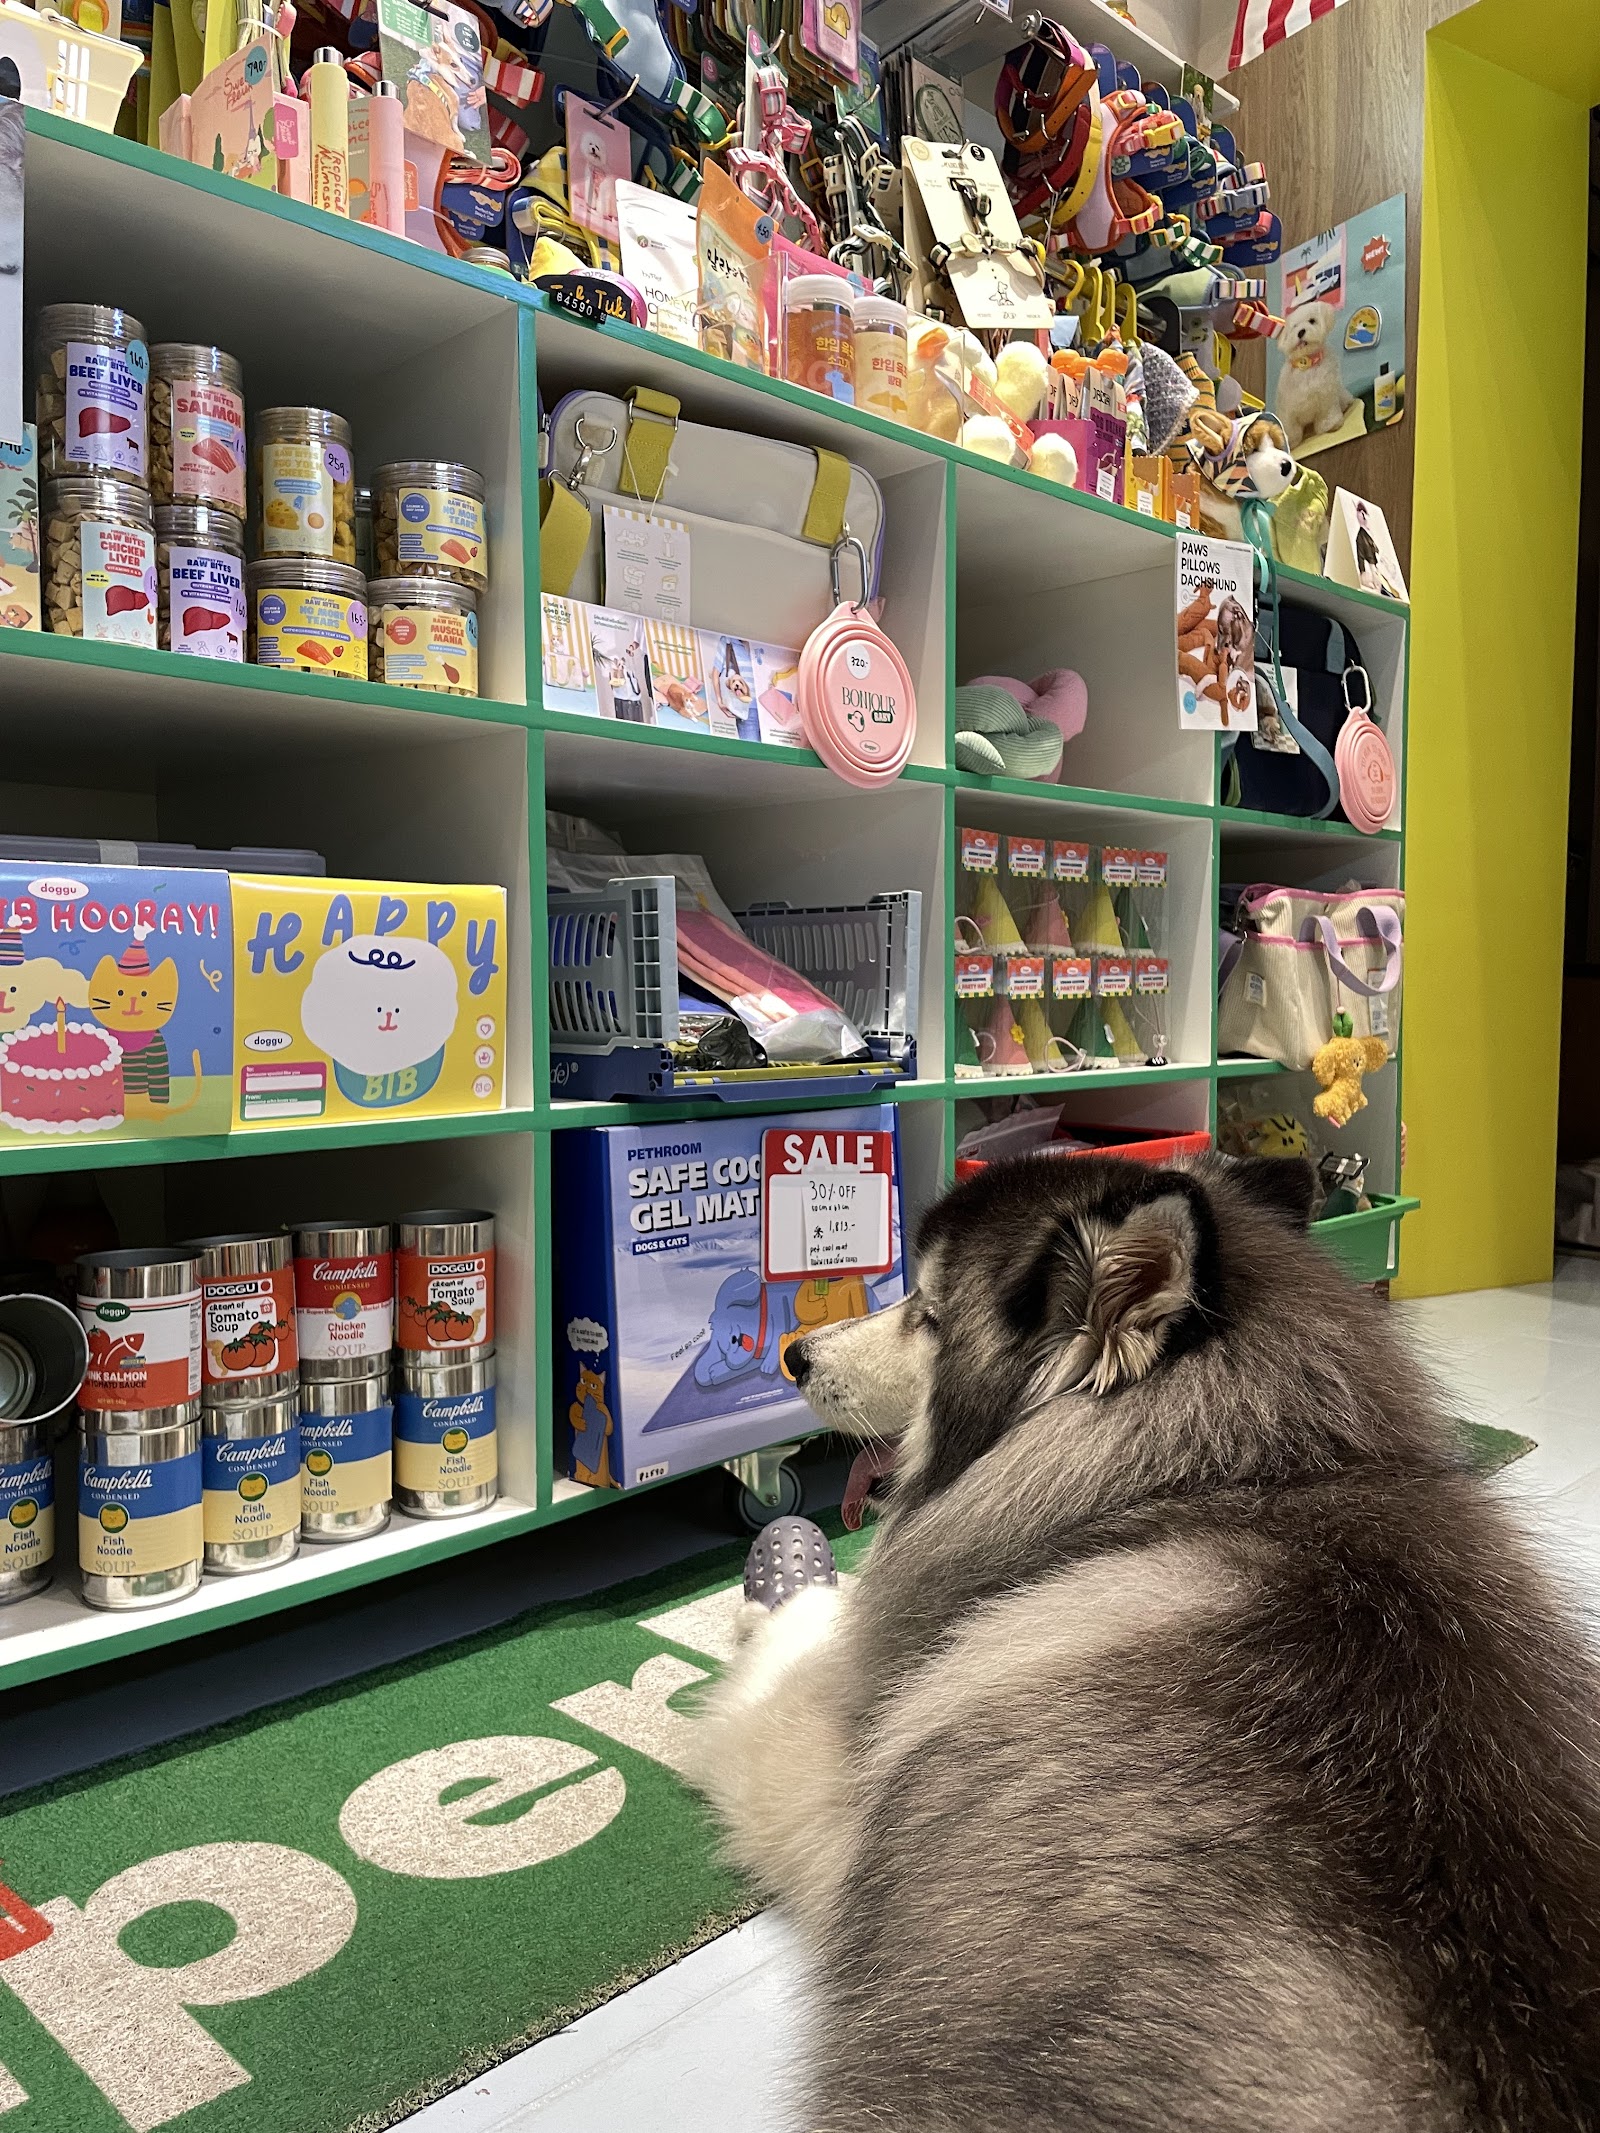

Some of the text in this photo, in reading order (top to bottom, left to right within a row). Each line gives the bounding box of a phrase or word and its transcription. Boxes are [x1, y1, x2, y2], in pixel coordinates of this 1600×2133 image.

[85, 355, 108, 367] RAW
[110, 361, 134, 376] BITE
[69, 364, 143, 395] BEEF LIVER
[176, 397, 242, 429] SALMON
[100, 540, 146, 558] CHICKEN
[1181, 541, 1209, 557] PAWS
[108, 552, 140, 567] LIVER
[210, 561, 232, 573] BITES
[1181, 557, 1221, 575] PILLOWS
[172, 567, 241, 589] BEEF LIVER
[1180, 573, 1237, 592] DACHSHUND
[299, 605, 345, 620] NO MORE
[306, 615, 340, 629] TEARS
[430, 624, 465, 638] MUSCLE
[433, 633, 463, 646] MANIA
[841, 686, 896, 715] BONJOUR
[40, 882, 77, 896] doggu
[51, 898, 220, 938] HOORAY!
[247, 893, 500, 996] HAPPY
[253, 1035, 284, 1047] doggu
[362, 1066, 418, 1102] BIB
[627, 1142, 702, 1161] PETHROOM
[783, 1134, 875, 1173] SALE
[628, 1154, 761, 1198] SAFE COO
[838, 1185, 857, 1200] OFF
[629, 1188, 761, 1234] GEL MAT
[634, 1240, 659, 1254] DOGS
[666, 1236, 688, 1250] CATS
[312, 1260, 379, 1284] Campbell's
[430, 1263, 475, 1275] DOGGU
[207, 1282, 257, 1297] DOGGU
[323, 1281, 371, 1292] CONDENSED
[430, 1287, 475, 1299] Tomato
[451, 1296, 475, 1306] Soup
[99, 1305, 127, 1317] doggu
[208, 1310, 260, 1325] Tomato
[210, 1322, 239, 1334] Soup
[327, 1321, 367, 1332] Chicken
[329, 1330, 365, 1341] Noodle
[327, 1342, 367, 1358] SOUP
[103, 1371, 147, 1381] SALMON
[119, 1380, 146, 1389] SAUCE
[422, 1395, 484, 1420] Campbell's
[300, 1418, 354, 1440] ampbell's
[433, 1416, 477, 1428] CONDENSED
[215, 1436, 287, 1465] Campbell's
[228, 1460, 278, 1473] CONDENSED
[446, 1455, 466, 1465] Fish
[439, 1463, 472, 1474] Noodle
[83, 1467, 153, 1492] Campbell's
[309, 1478, 329, 1487] Fish
[437, 1475, 475, 1490] SOUP
[91, 1491, 140, 1500] CONDENSED
[303, 1486, 337, 1497] Noodle
[242, 1503, 265, 1514] Fish
[301, 1499, 340, 1513] SOUP
[234, 1510, 272, 1524] Noodle
[13, 1529, 35, 1542] Fish
[232, 1524, 274, 1541] SOUP
[5, 1536, 41, 1554] Noodle
[103, 1536, 125, 1545] Fish
[96, 1545, 133, 1556] Noodle
[2, 1549, 43, 1571] SOUP
[94, 1559, 137, 1574] SOUP
